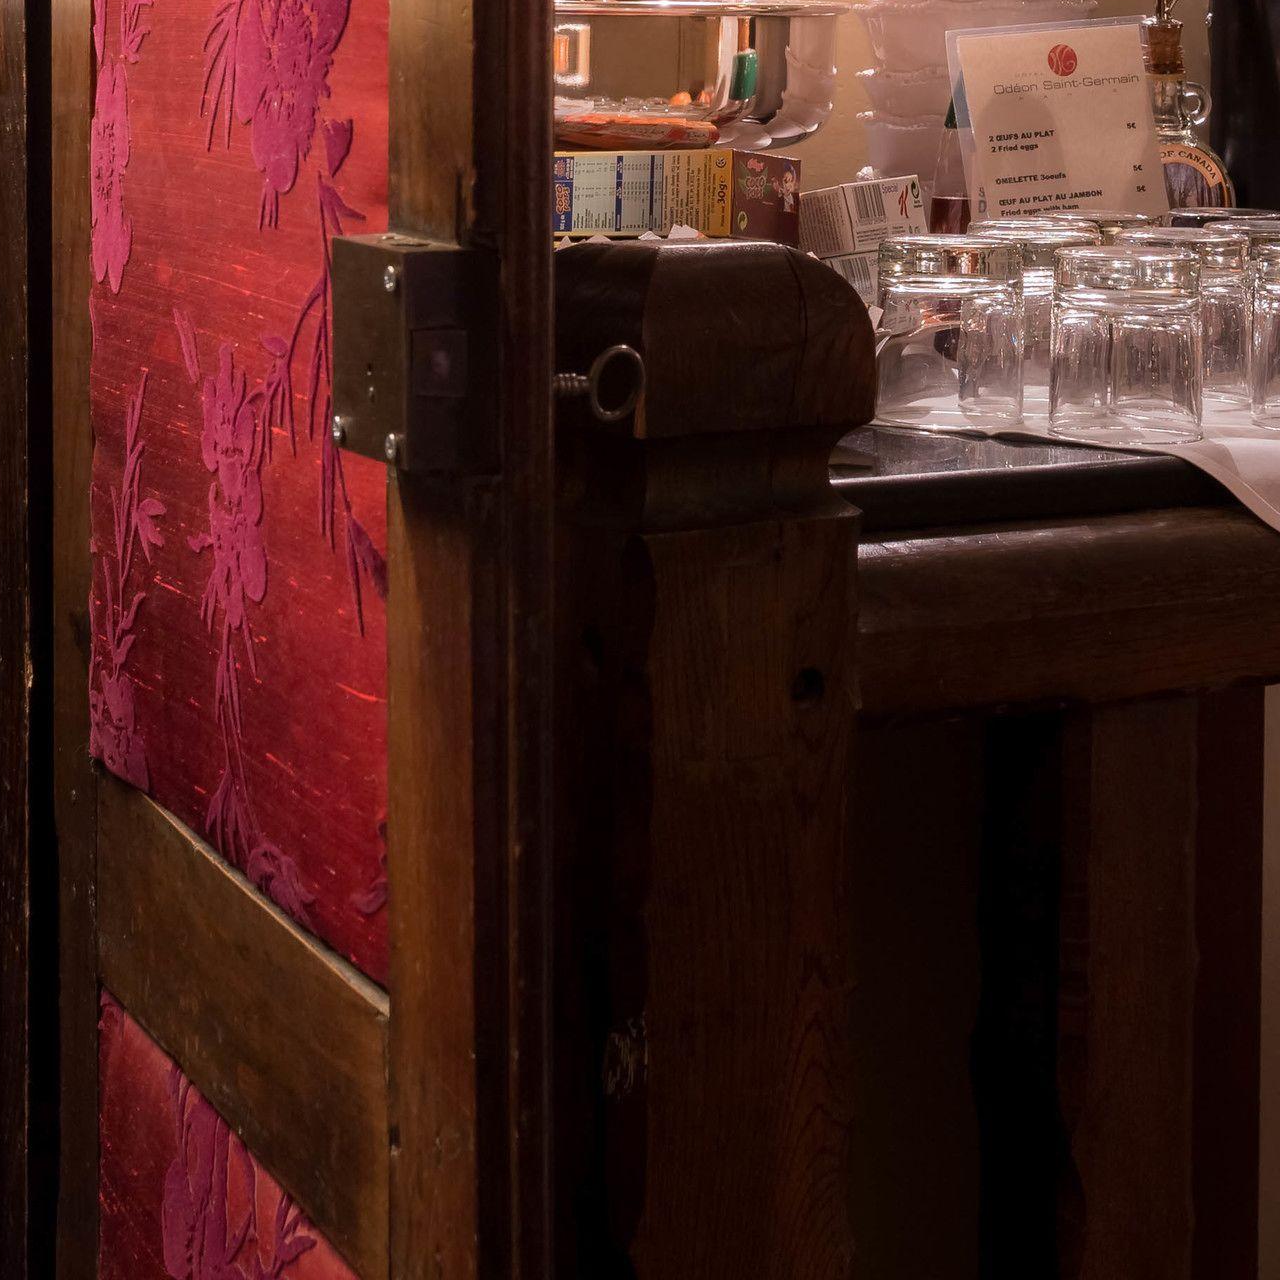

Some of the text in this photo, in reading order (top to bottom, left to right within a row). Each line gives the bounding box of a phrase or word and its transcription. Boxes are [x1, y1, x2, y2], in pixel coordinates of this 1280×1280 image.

[994, 74, 1140, 95] Odéon Saint-Germain
[1034, 129, 1055, 138] PLAT
[998, 144, 1018, 152] Fried
[1020, 143, 1039, 152] eggs
[1178, 150, 1216, 179] CANADA
[995, 175, 1038, 185] OMELETTE
[882, 183, 898, 194] Special
[898, 185, 909, 218] K
[1032, 194, 1053, 203] PLAT
[1055, 193, 1067, 201] AU
[1069, 190, 1103, 199] JAMBON
[1001, 209, 1021, 217] Fried
